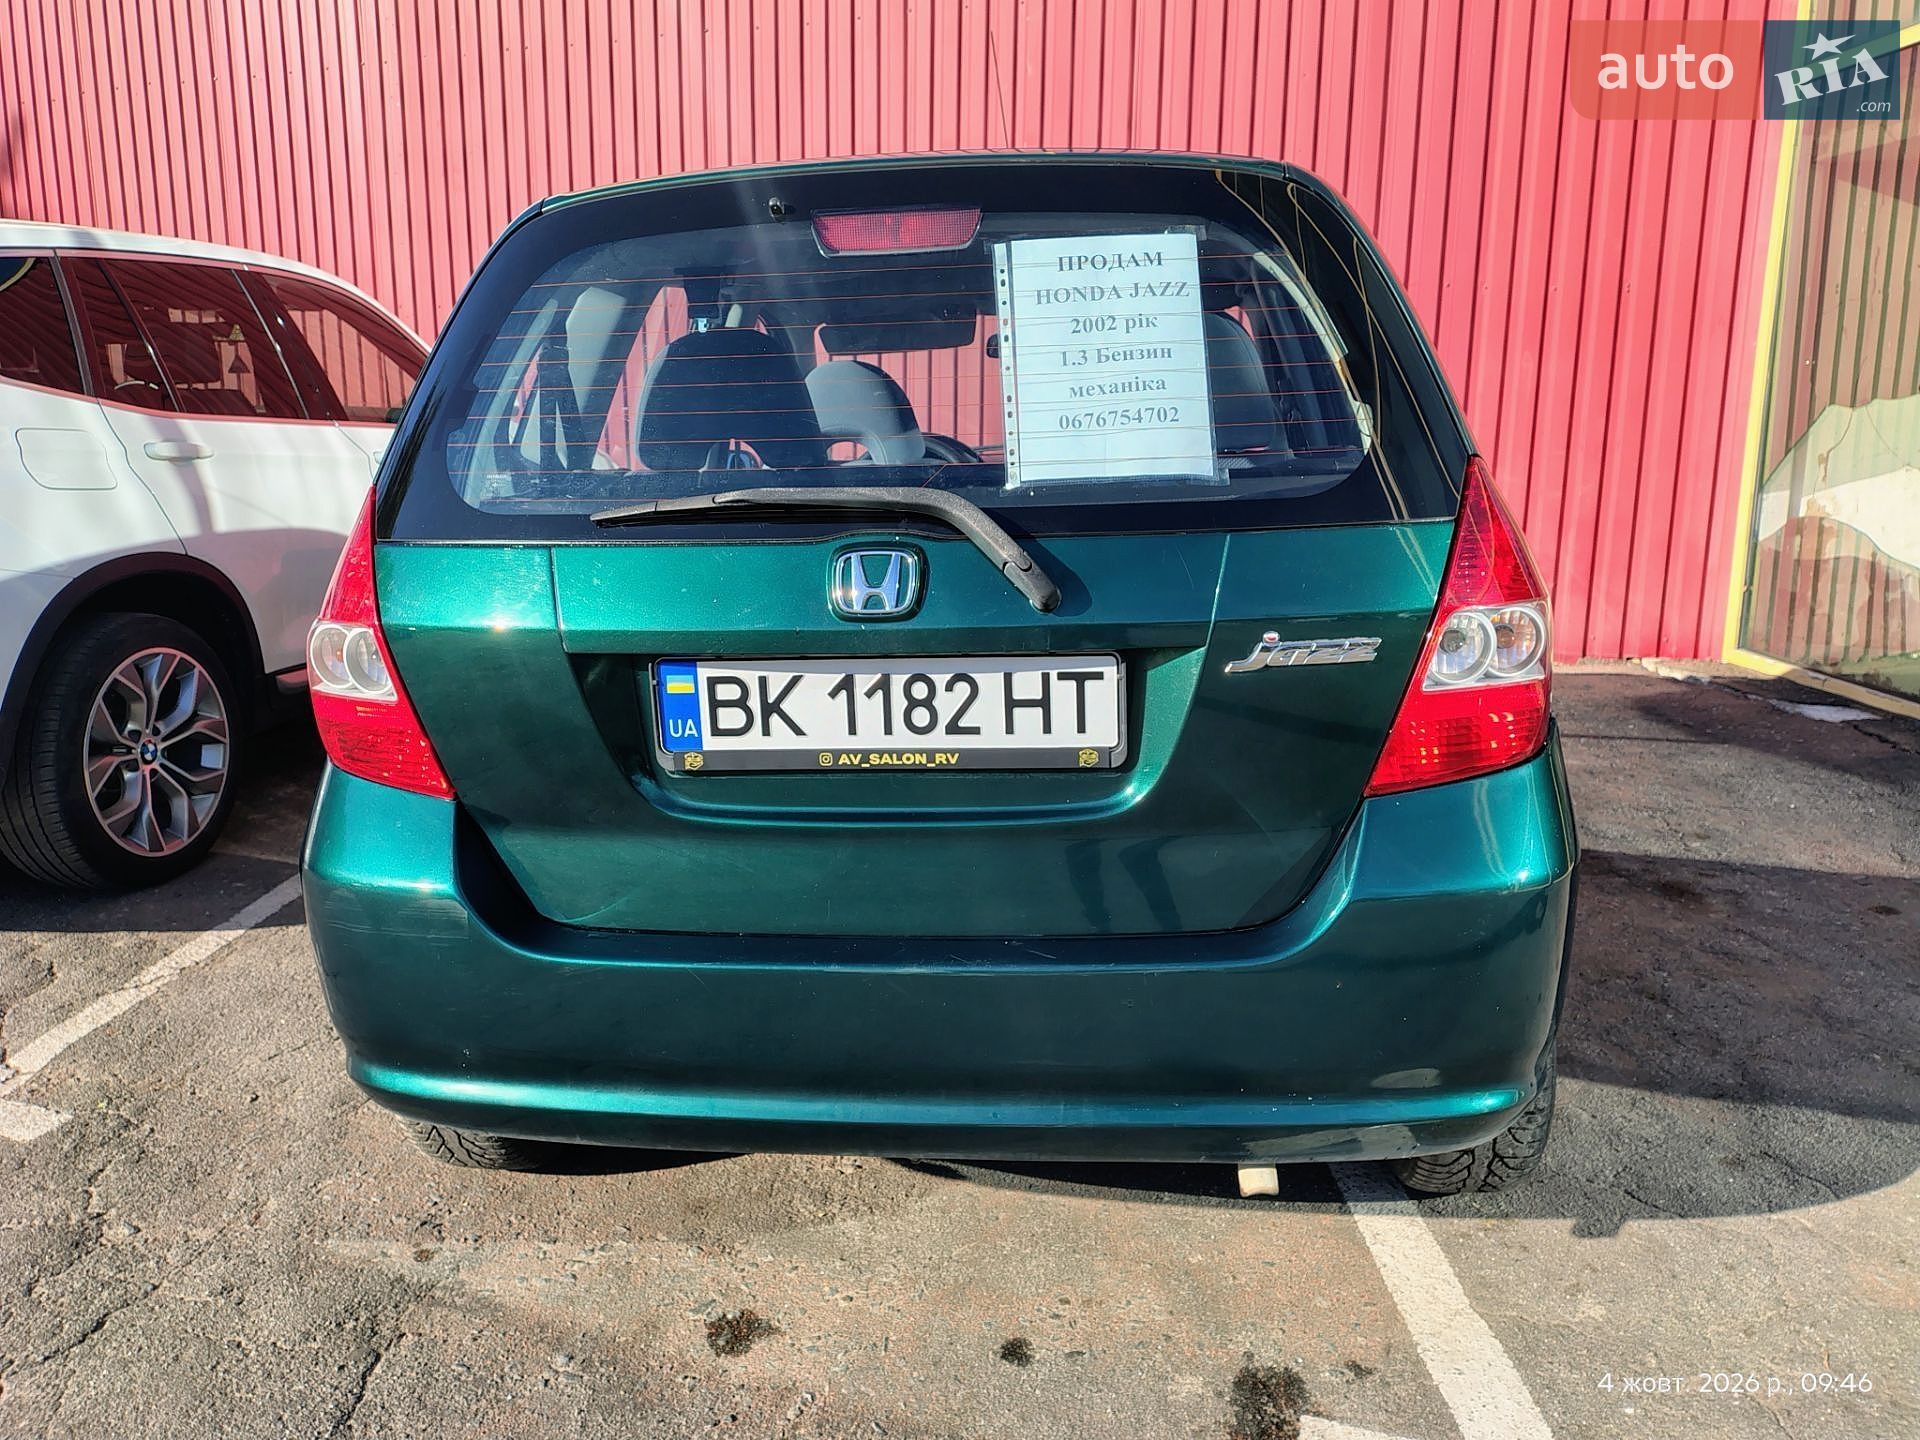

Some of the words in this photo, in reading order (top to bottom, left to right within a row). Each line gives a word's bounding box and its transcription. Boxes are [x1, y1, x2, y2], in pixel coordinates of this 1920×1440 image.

[1057, 251, 1163, 273] ПРОДАМ
[1036, 284, 1122, 305] HONDA
[1129, 281, 1190, 299] JAZZ
[1071, 315, 1117, 334] 2002
[1125, 313, 1159, 333] рік
[1060, 349, 1088, 367] 1.3
[1096, 346, 1172, 365] Бензин
[1069, 377, 1167, 398] механіка
[1059, 406, 1180, 430] 0676754702
[705, 674, 808, 738] BK
[827, 672, 981, 737] 1182
[1005, 671, 1104, 735] HT
[669, 719, 699, 739] UA
[838, 752, 960, 767] AV_SALON_RV
